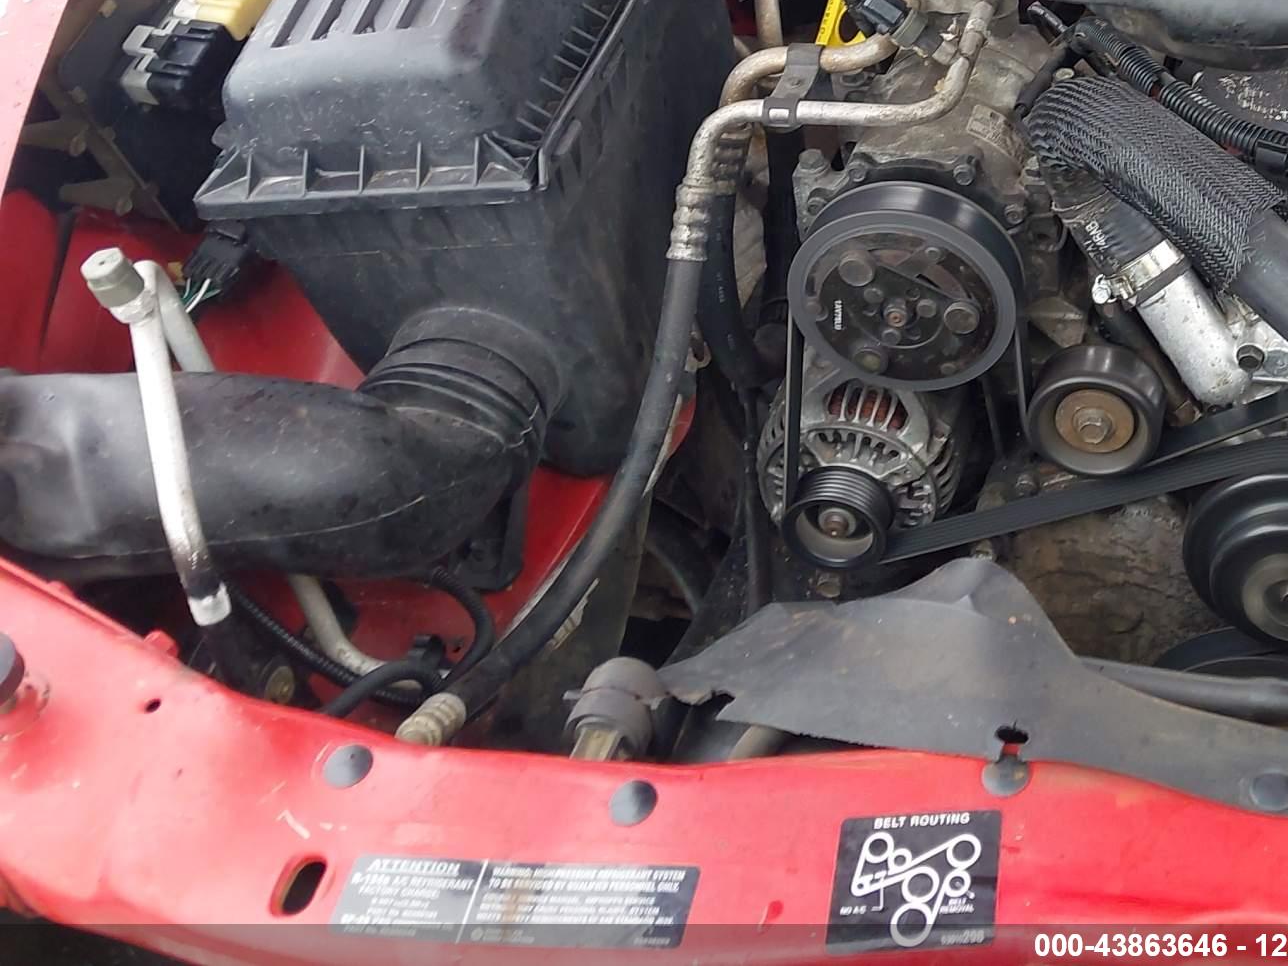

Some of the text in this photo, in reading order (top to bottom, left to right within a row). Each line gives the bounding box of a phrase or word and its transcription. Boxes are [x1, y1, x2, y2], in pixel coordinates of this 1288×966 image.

[874, 812, 971, 830] BELT ROUTING
[367, 857, 460, 876] ATTENTION
